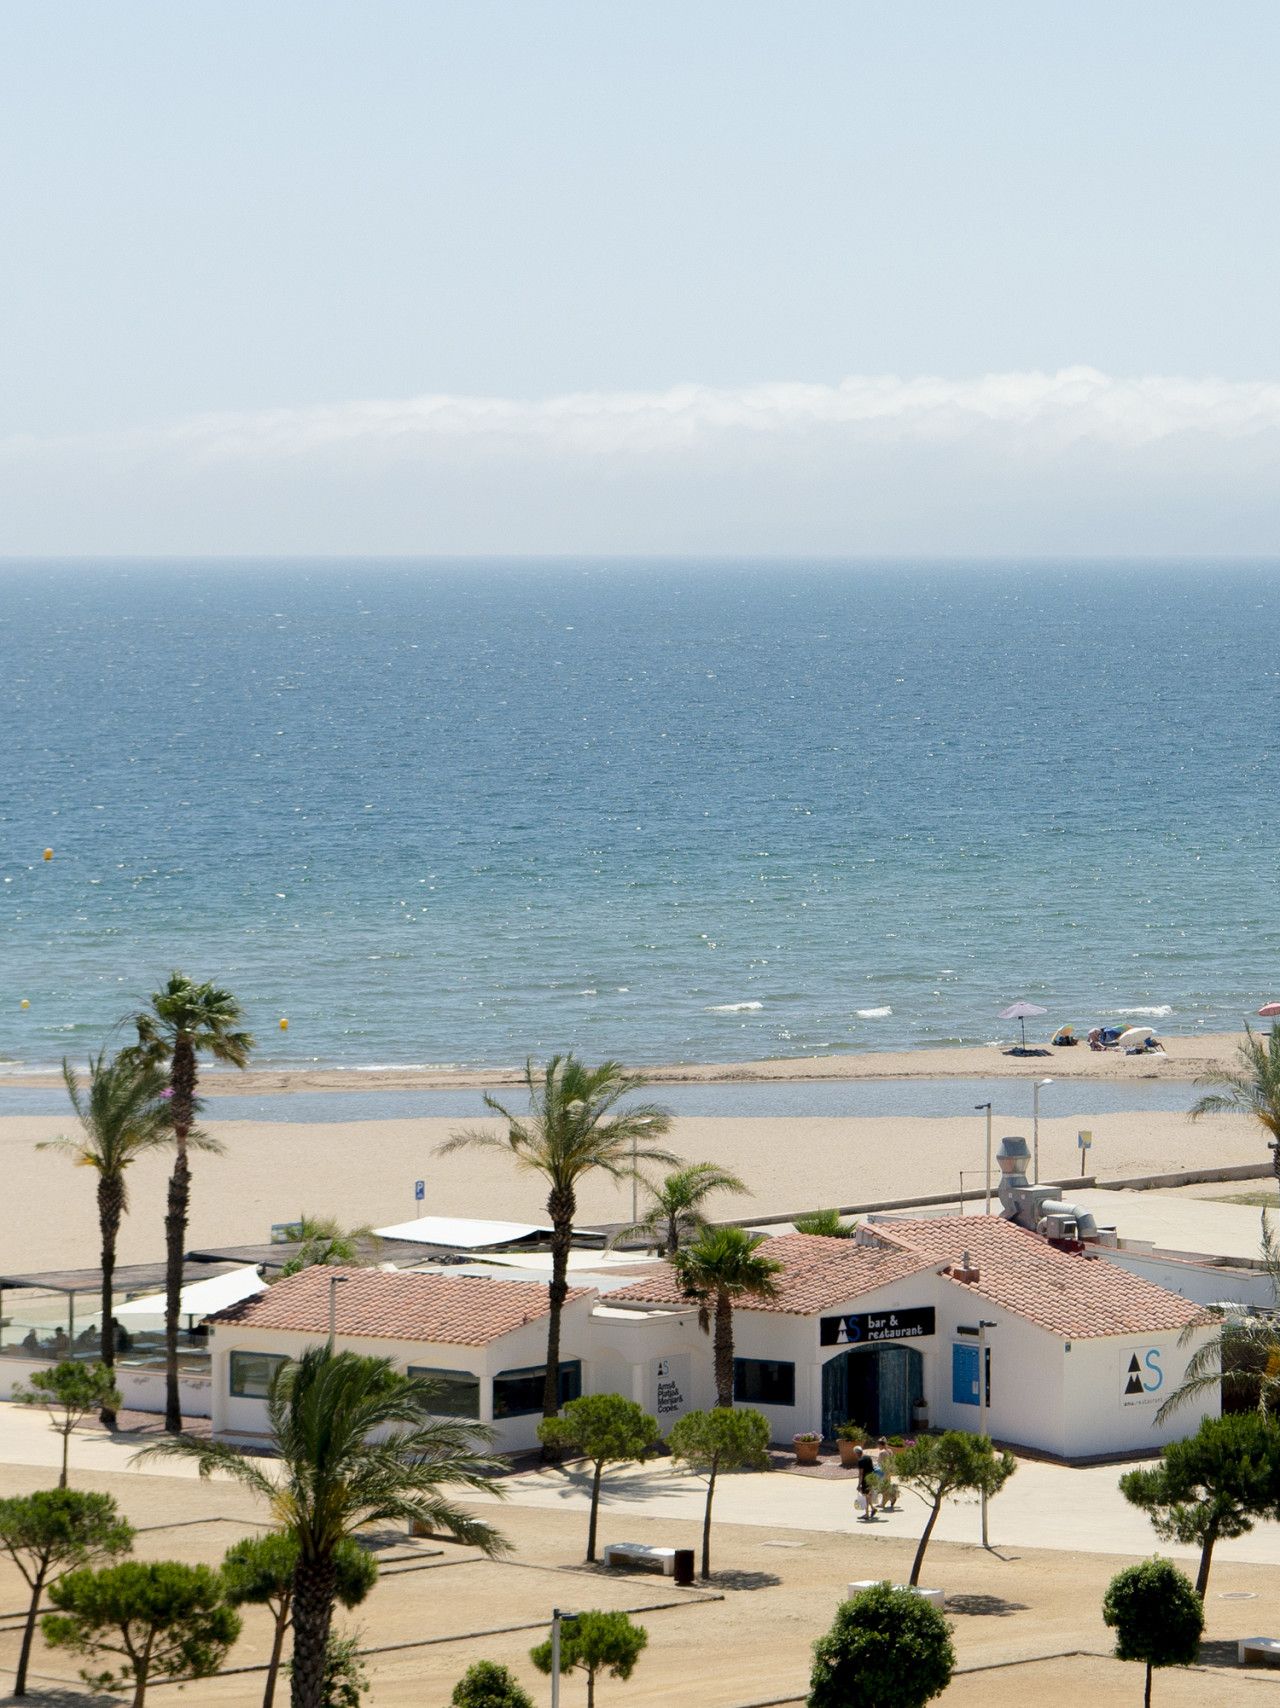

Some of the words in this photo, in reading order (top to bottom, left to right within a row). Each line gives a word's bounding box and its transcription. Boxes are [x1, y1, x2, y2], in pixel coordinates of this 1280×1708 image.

[868, 1315, 887, 1329] bar
[889, 1314, 899, 1327] &
[868, 1325, 923, 1340] restaurant
